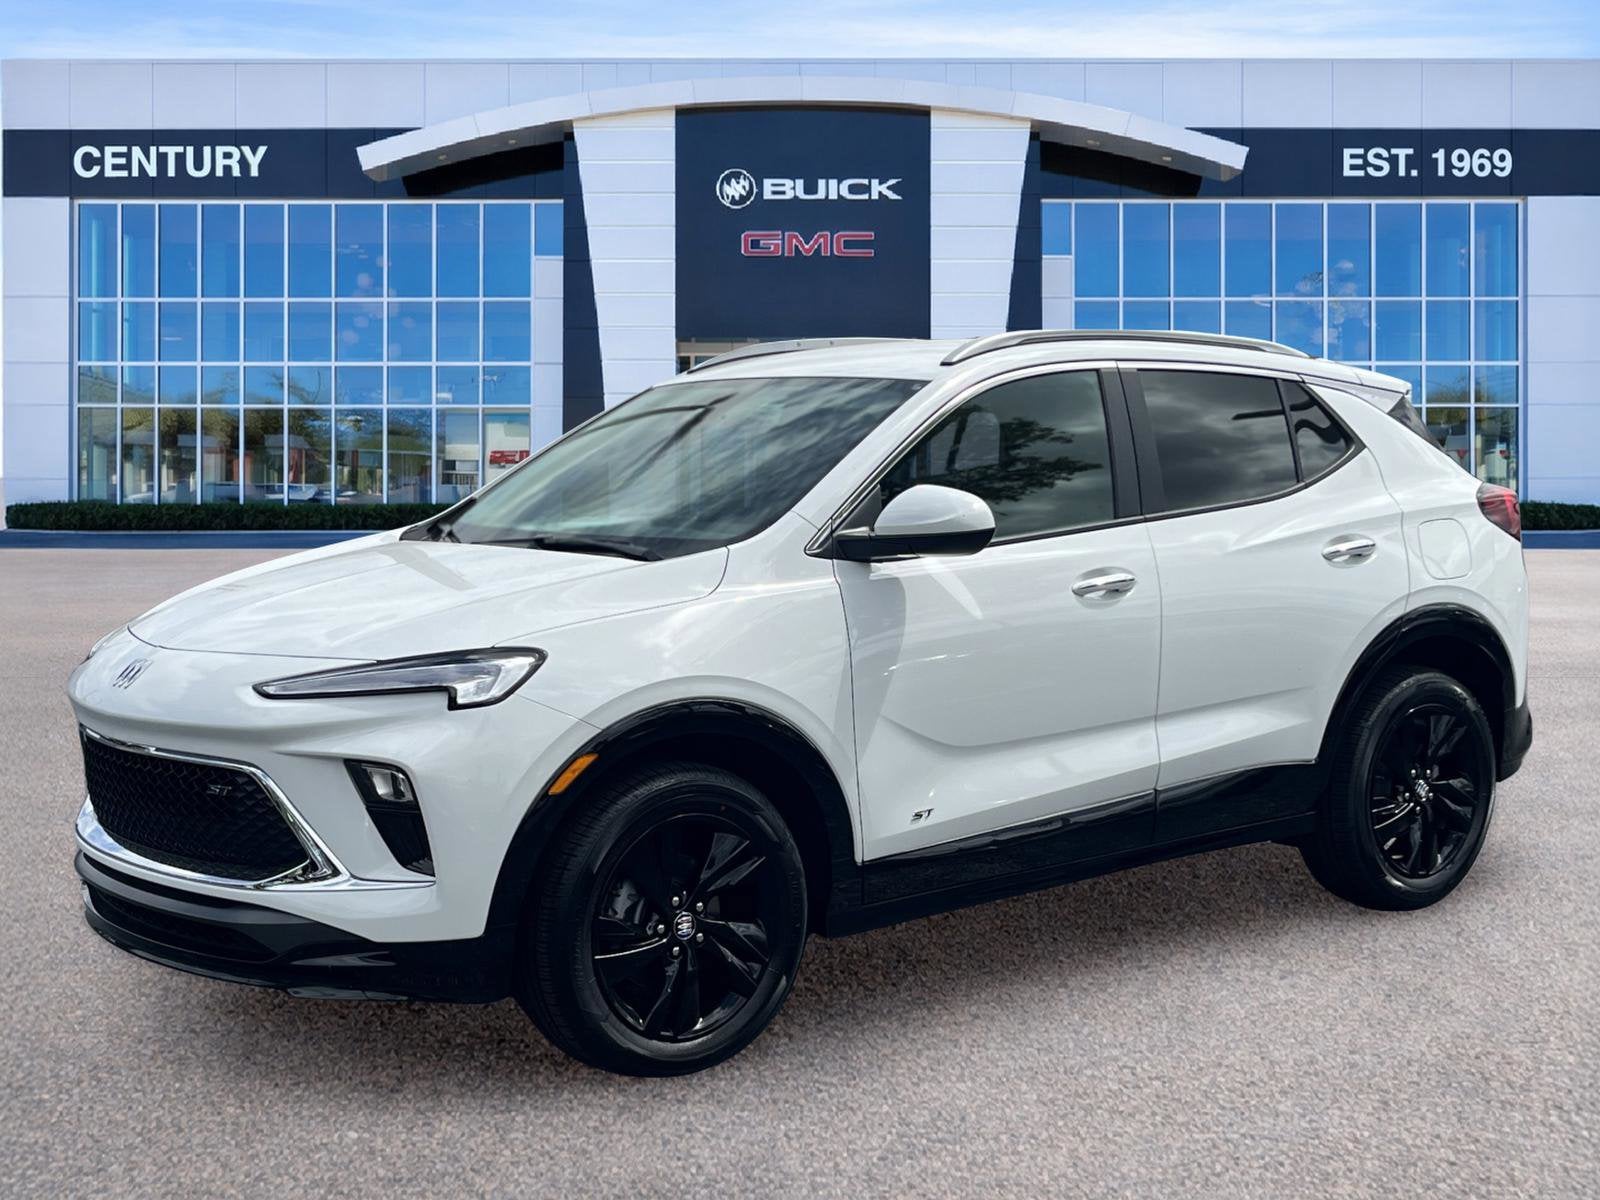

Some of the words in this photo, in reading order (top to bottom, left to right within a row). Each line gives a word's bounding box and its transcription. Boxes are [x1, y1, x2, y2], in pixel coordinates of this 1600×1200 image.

[73, 144, 268, 178] CENTURY
[1343, 147, 1418, 177] EST.
[1431, 147, 1513, 178] 1969
[763, 178, 903, 200] BUICK
[741, 231, 875, 257] GMC
[207, 784, 232, 797] ST
[911, 808, 935, 823] ST
